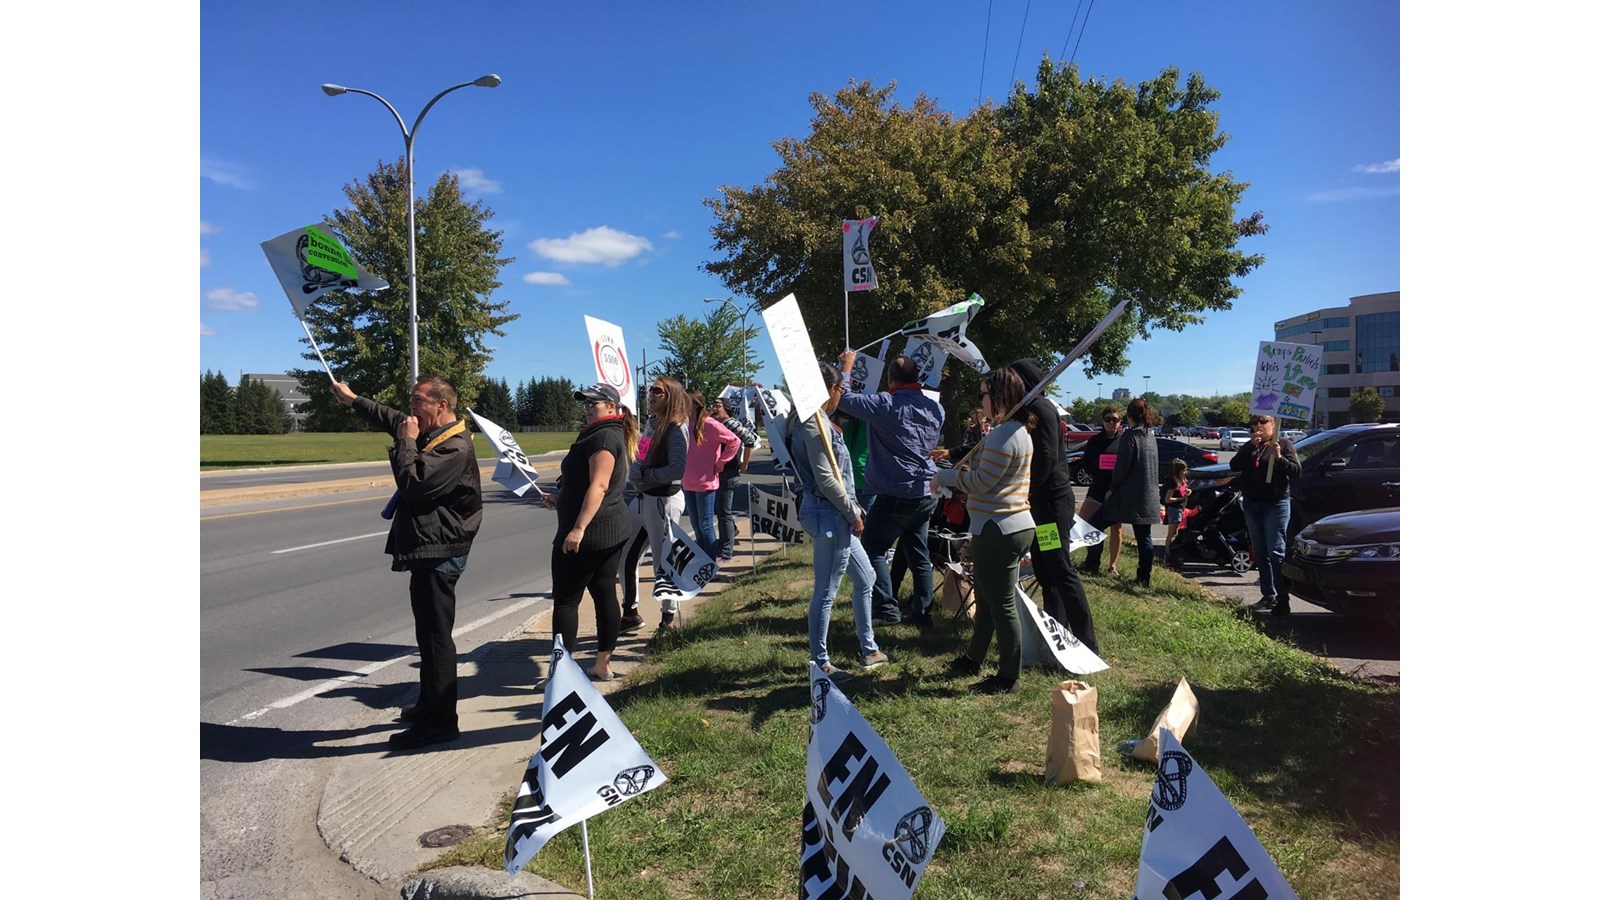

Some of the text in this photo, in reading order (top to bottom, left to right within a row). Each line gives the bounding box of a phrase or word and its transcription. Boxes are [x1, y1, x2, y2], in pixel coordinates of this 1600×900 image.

[310, 237, 342, 259] bonne
[503, 449, 532, 467] CS
[752, 514, 804, 544] GRÈVE
[767, 498, 789, 521] EN
[666, 538, 696, 577] EN
[541, 691, 610, 780] EN
[817, 731, 891, 843] EN
[882, 841, 916, 889] CSN
[1162, 836, 1269, 900] E
